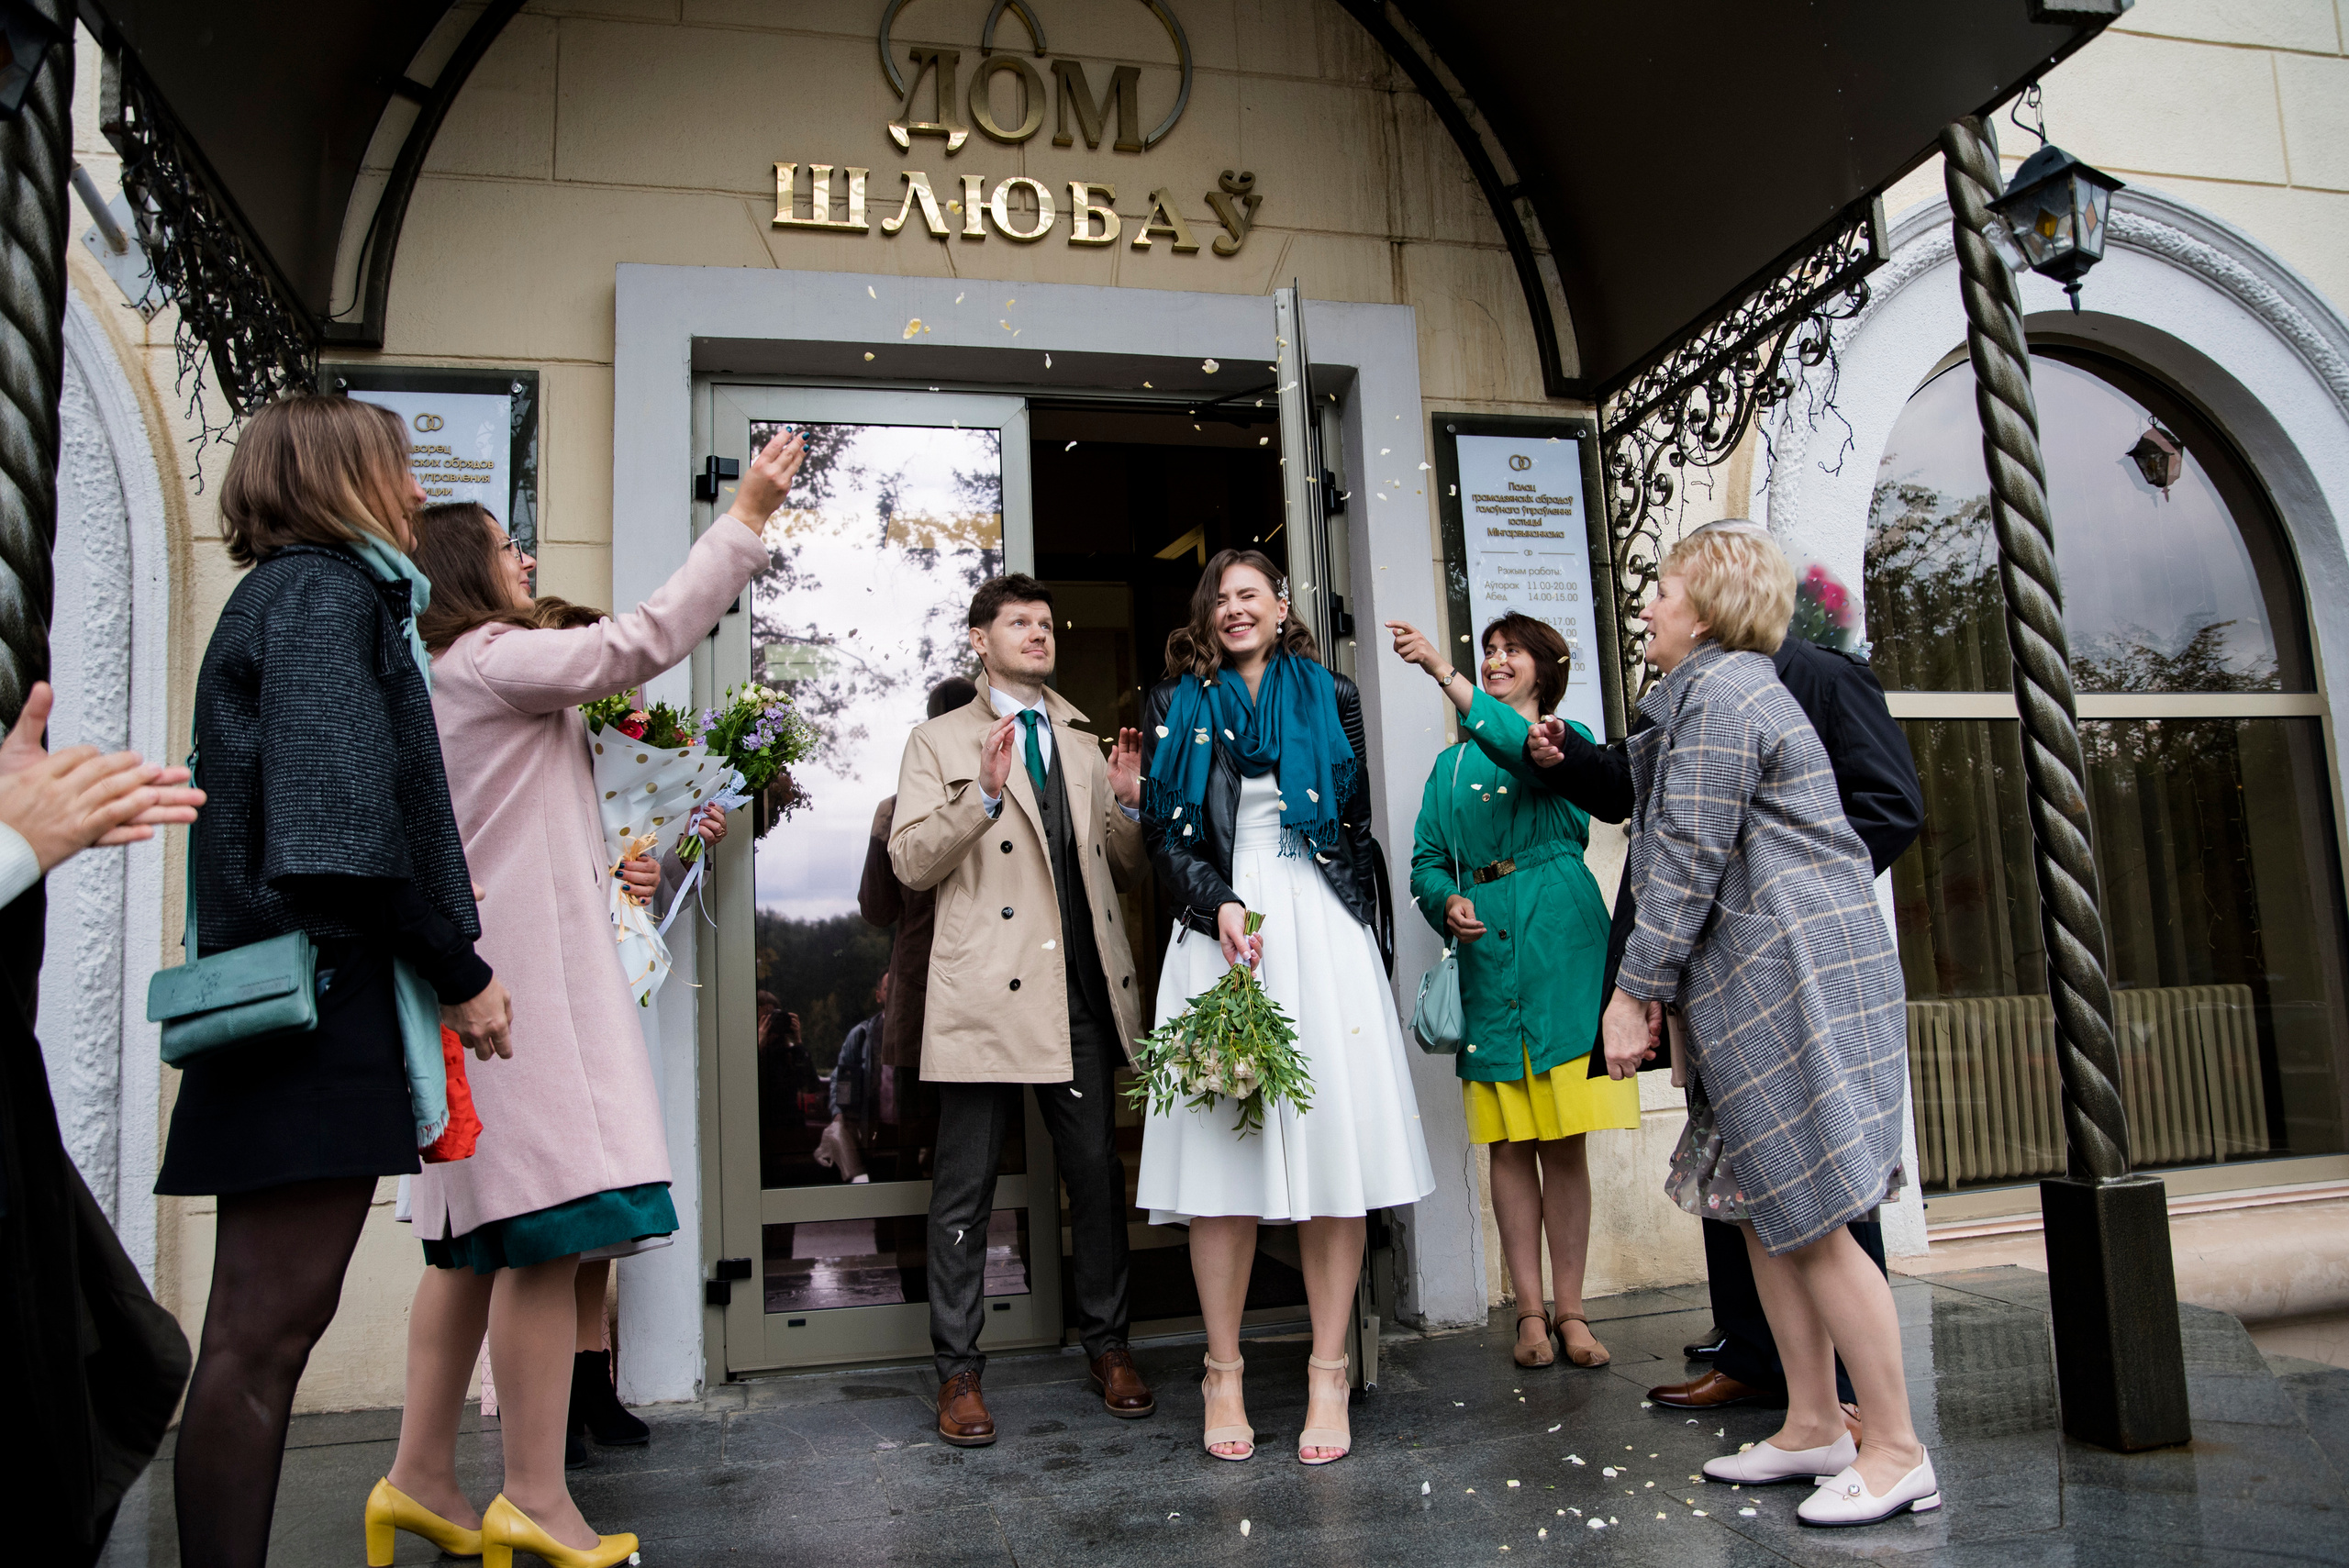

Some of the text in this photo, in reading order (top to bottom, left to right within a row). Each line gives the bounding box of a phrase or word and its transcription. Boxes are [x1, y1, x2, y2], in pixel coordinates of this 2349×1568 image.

[888, 46, 1143, 157] ДОМ
[772, 161, 1264, 257] ШЛЮБАЎ
[443, 457, 495, 472] обрядов
[419, 473, 491, 484] управления
[1508, 482, 1537, 493] Палац
[1471, 494, 1574, 506] грамадзянскіх абрадаў
[1475, 505, 1520, 516] галоўнага
[1508, 517, 1542, 527] юстыцыі
[1486, 528, 1565, 539] Мінгарвыканкама
[1497, 566, 1563, 577] Рэжым работы:
[1484, 581, 1577, 591] Аўторак 11.00-20.00
[1486, 592, 1578, 602] Абед 14.00-15.00
